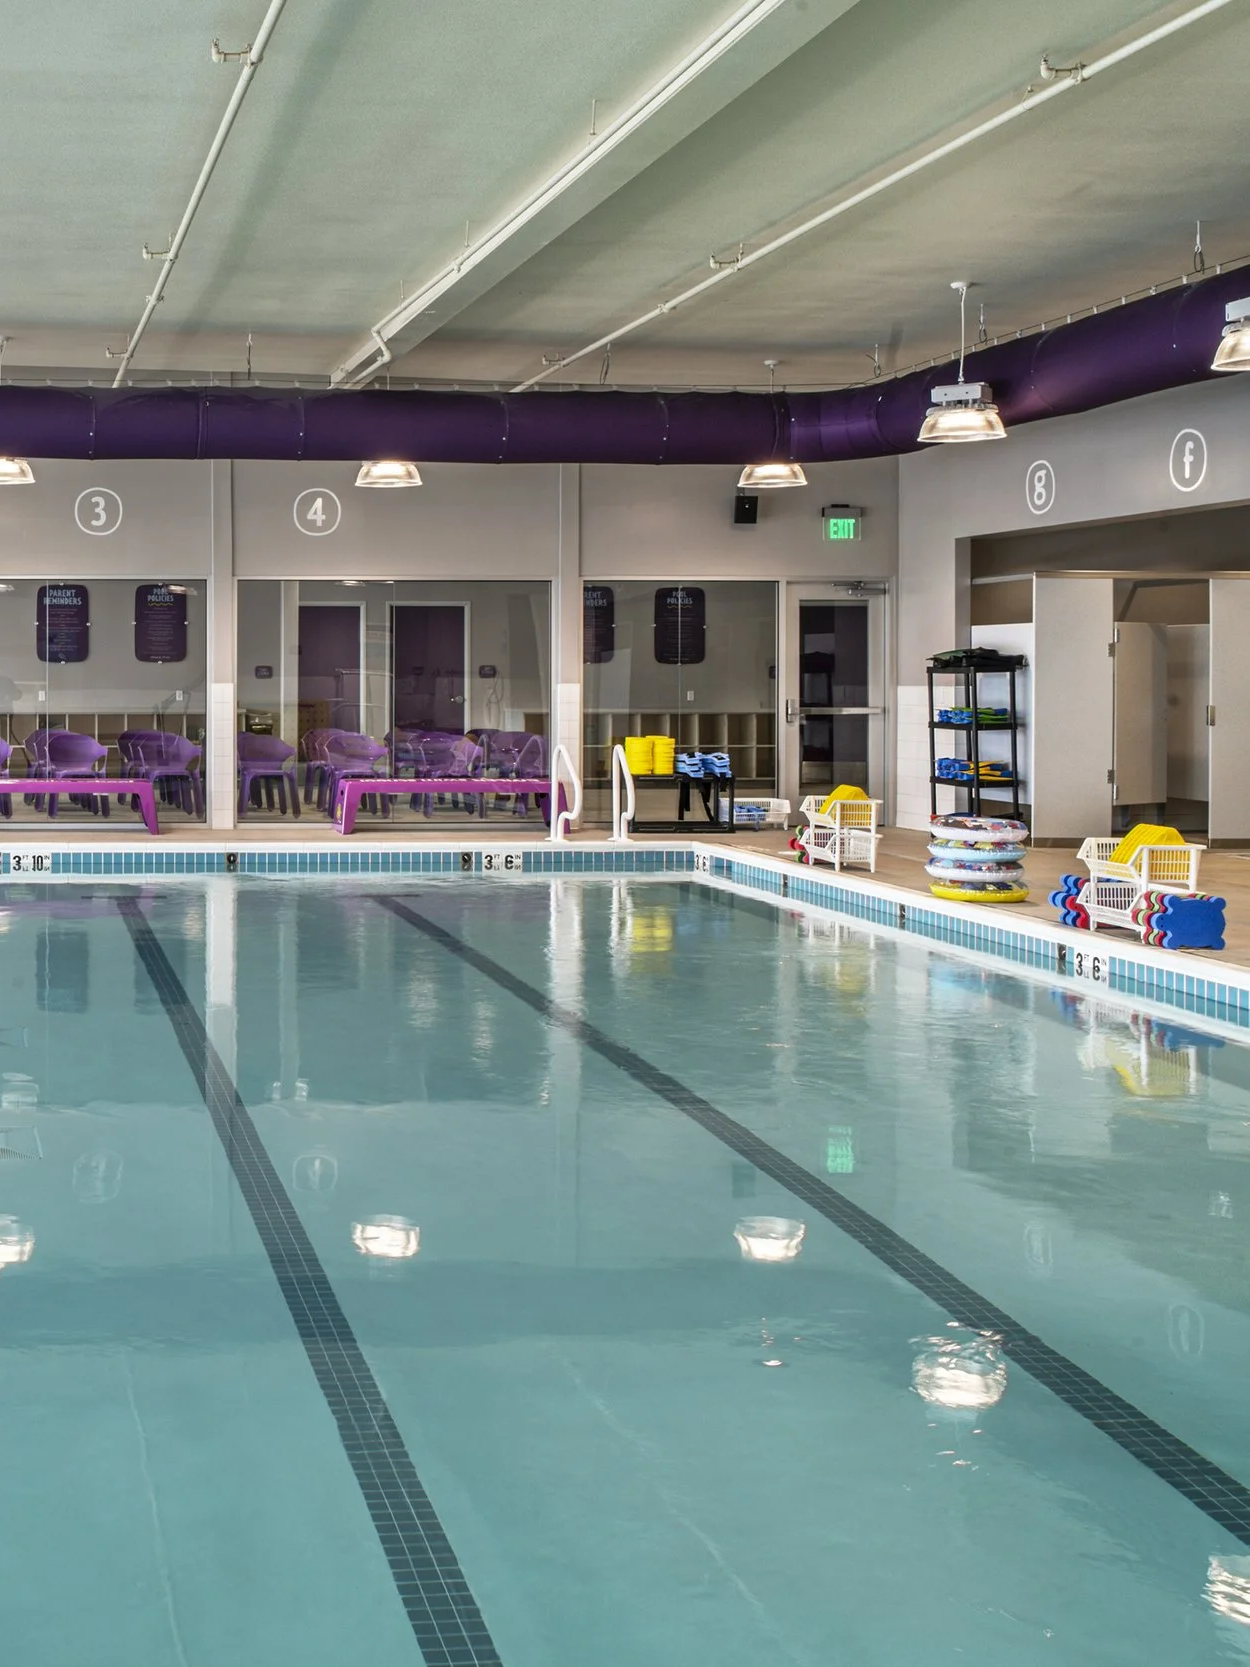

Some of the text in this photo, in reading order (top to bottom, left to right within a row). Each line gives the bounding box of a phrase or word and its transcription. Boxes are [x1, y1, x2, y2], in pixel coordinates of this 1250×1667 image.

[1183, 440, 1194, 479] f
[1034, 469, 1047, 506] g
[90, 496, 107, 526] 3
[306, 497, 326, 527] 4
[830, 518, 855, 539] EXIT
[43, 597, 82, 606] REMINDERS
[49, 589, 76, 598] PARENT
[667, 597, 693, 605] POLICIES
[12, 855, 21, 870] 3
[32, 855, 43, 870] 10
[484, 854, 493, 869] 3
